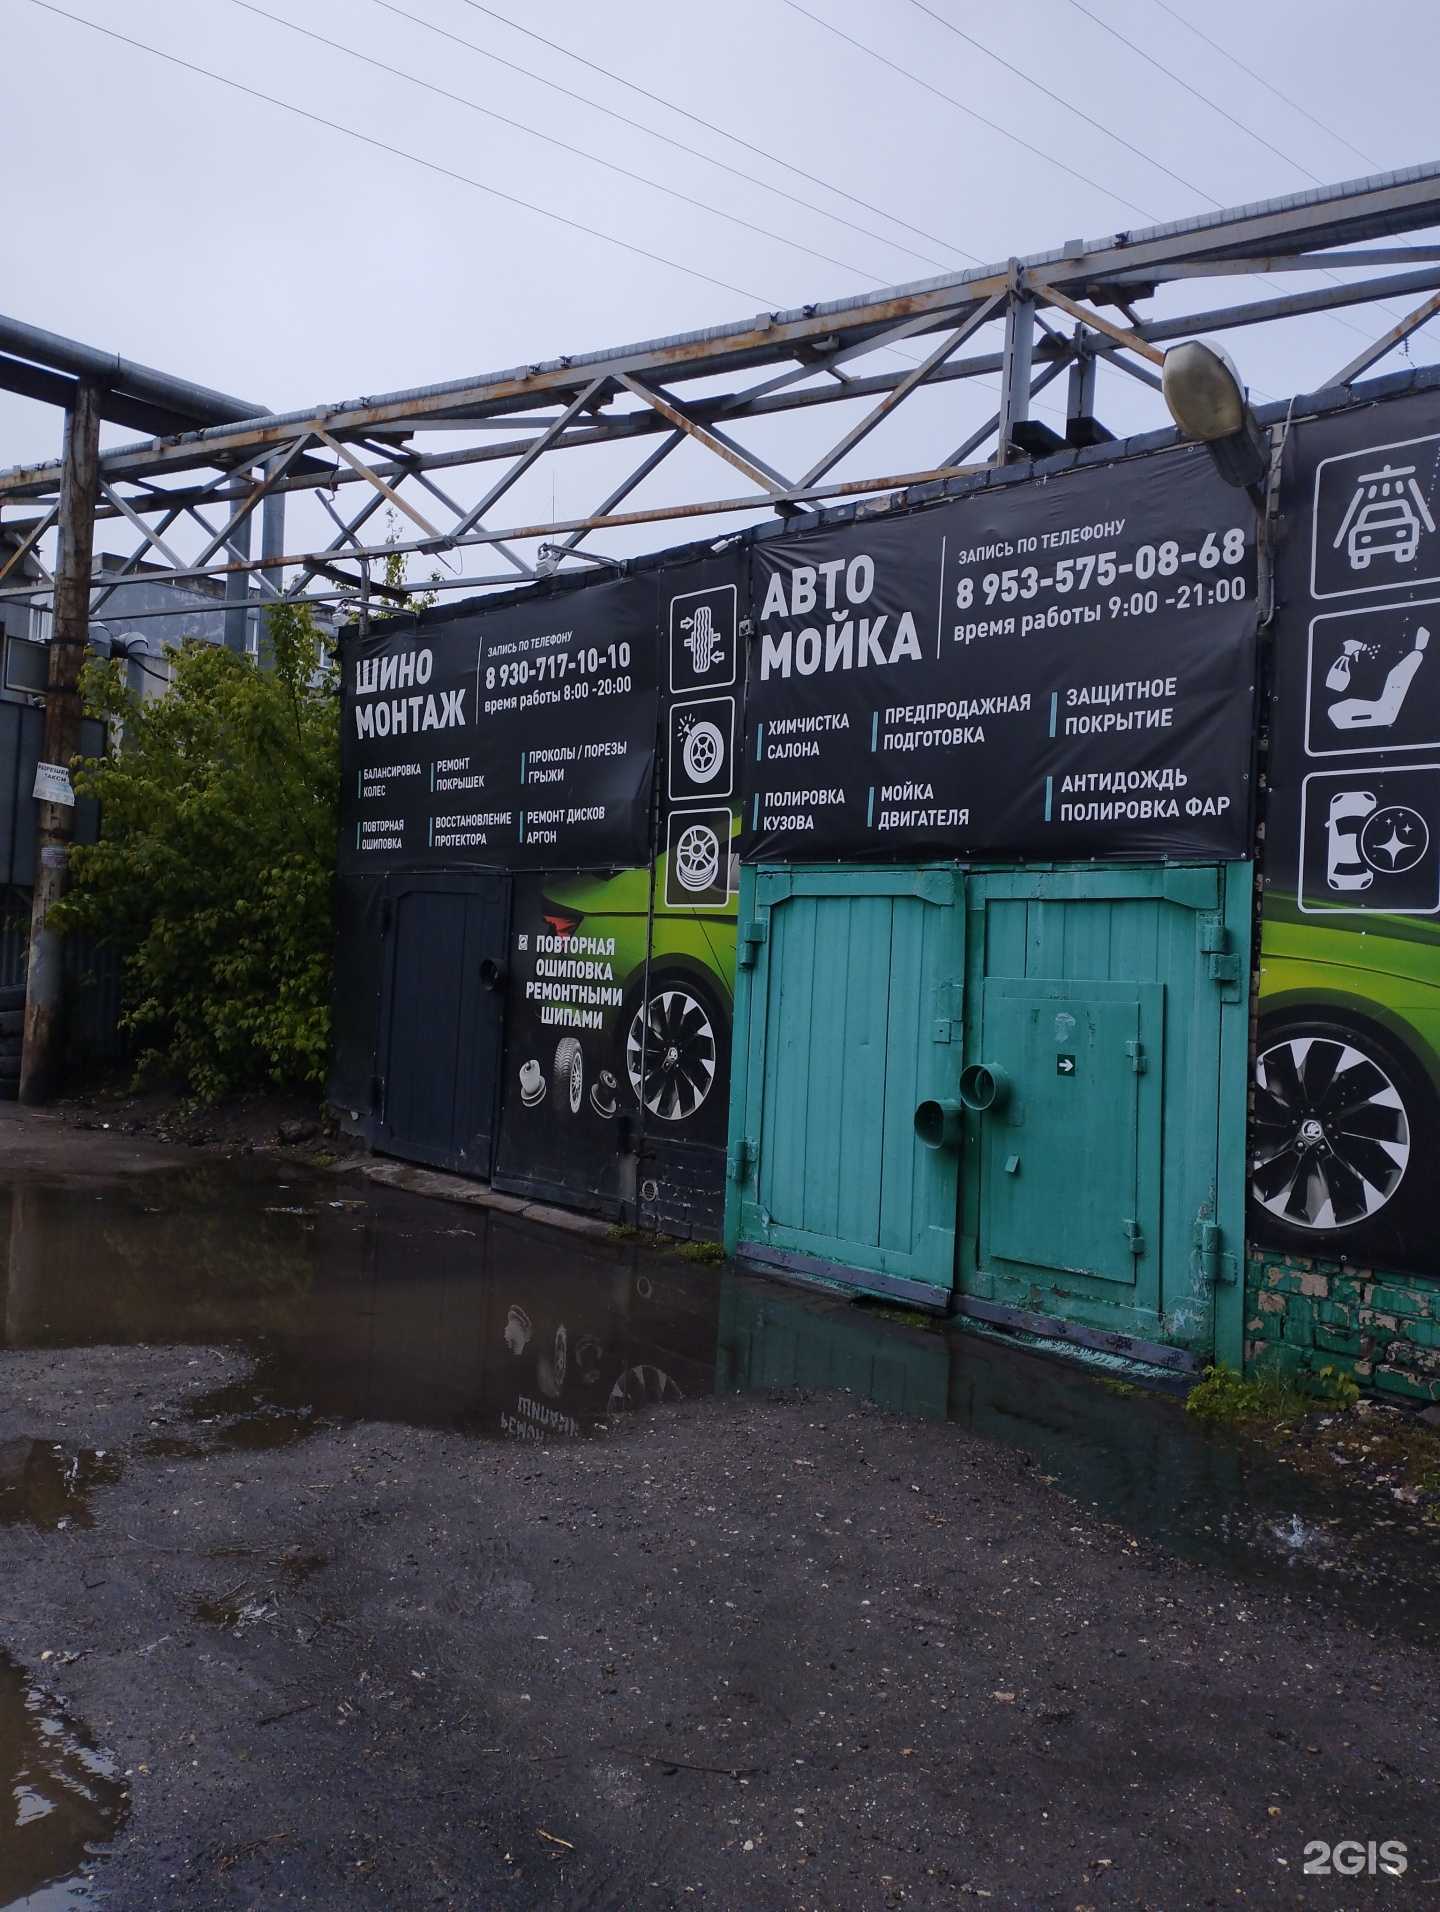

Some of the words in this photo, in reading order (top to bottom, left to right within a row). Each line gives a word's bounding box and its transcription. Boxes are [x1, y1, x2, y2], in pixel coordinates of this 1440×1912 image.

[959, 541, 1014, 565] ЗАПИСЬ
[1017, 536, 1037, 554] ПО
[1041, 519, 1126, 547] ТЕЛЕФОНУ
[956, 578, 974, 609] 8
[982, 528, 1245, 606] 953-575-08-68
[761, 555, 874, 621] АВТО
[954, 617, 1015, 644] время
[1022, 604, 1100, 636] работы
[1108, 590, 1157, 618] 9:00
[488, 643, 517, 657] ЗАПИСЬ
[519, 640, 529, 651] ПО
[531, 631, 573, 649] ТЕЛЕФОНУ
[761, 609, 922, 681] МОЙКА
[356, 649, 433, 694] ШИНО
[485, 666, 496, 689] 8
[500, 642, 631, 687] 930-717-10-10
[484, 696, 518, 715] время
[520, 689, 561, 711] работы
[563, 682, 589, 701] 8:00
[1066, 677, 1177, 708] ЗАЩИТНОЕ
[355, 689, 466, 739] МОНТАЖ
[884, 693, 1031, 725] ПРЕДПРОДАЖНАЯ
[768, 712, 850, 736] ХИМЧИСТКА
[1065, 708, 1173, 736] ПОКРЫТИЕ
[768, 740, 820, 760] САЛОНА
[884, 726, 985, 752] ПОДГОТОВКА
[437, 757, 470, 772] РЕМОНТ
[529, 746, 576, 764] ПРОКОЛЫ
[577, 745, 583, 760] /
[584, 741, 627, 758] ПОРЕЗЫ
[363, 763, 421, 780] БАЛАНСИРОВКА
[436, 775, 485, 791] ПОКРЫШЕК
[528, 768, 565, 784] ГРЫЖИ
[1061, 767, 1188, 794] АНТИДОЖДЬ
[363, 785, 386, 797] КОЛЕС
[764, 788, 845, 808] ПОЛИРОВКА
[881, 783, 934, 802] МОЙКА
[435, 811, 512, 828] ВОССТАНОВЛЕНИЕ
[527, 809, 565, 824] РЕМОНТ
[567, 806, 605, 824] ДИСКОВ
[878, 807, 969, 831] ДВИГАТЕЛЯ
[1060, 800, 1180, 822] ПОЛИРОВКА
[1185, 796, 1231, 818] ФАР
[362, 819, 404, 832] ПОВТОРНАЯ
[764, 814, 814, 832] КУЗОВА
[362, 838, 402, 850] ОШИПОВКА
[435, 833, 487, 847] ПРОТЕКТОРА
[527, 830, 557, 844] АРГОН
[536, 935, 615, 956] ПОВТОРНАЯ
[535, 958, 613, 981] ОШИПОВКА
[526, 981, 623, 1006] РЕМОНТНЫМИ
[541, 1006, 603, 1030] ШИПАМИ
